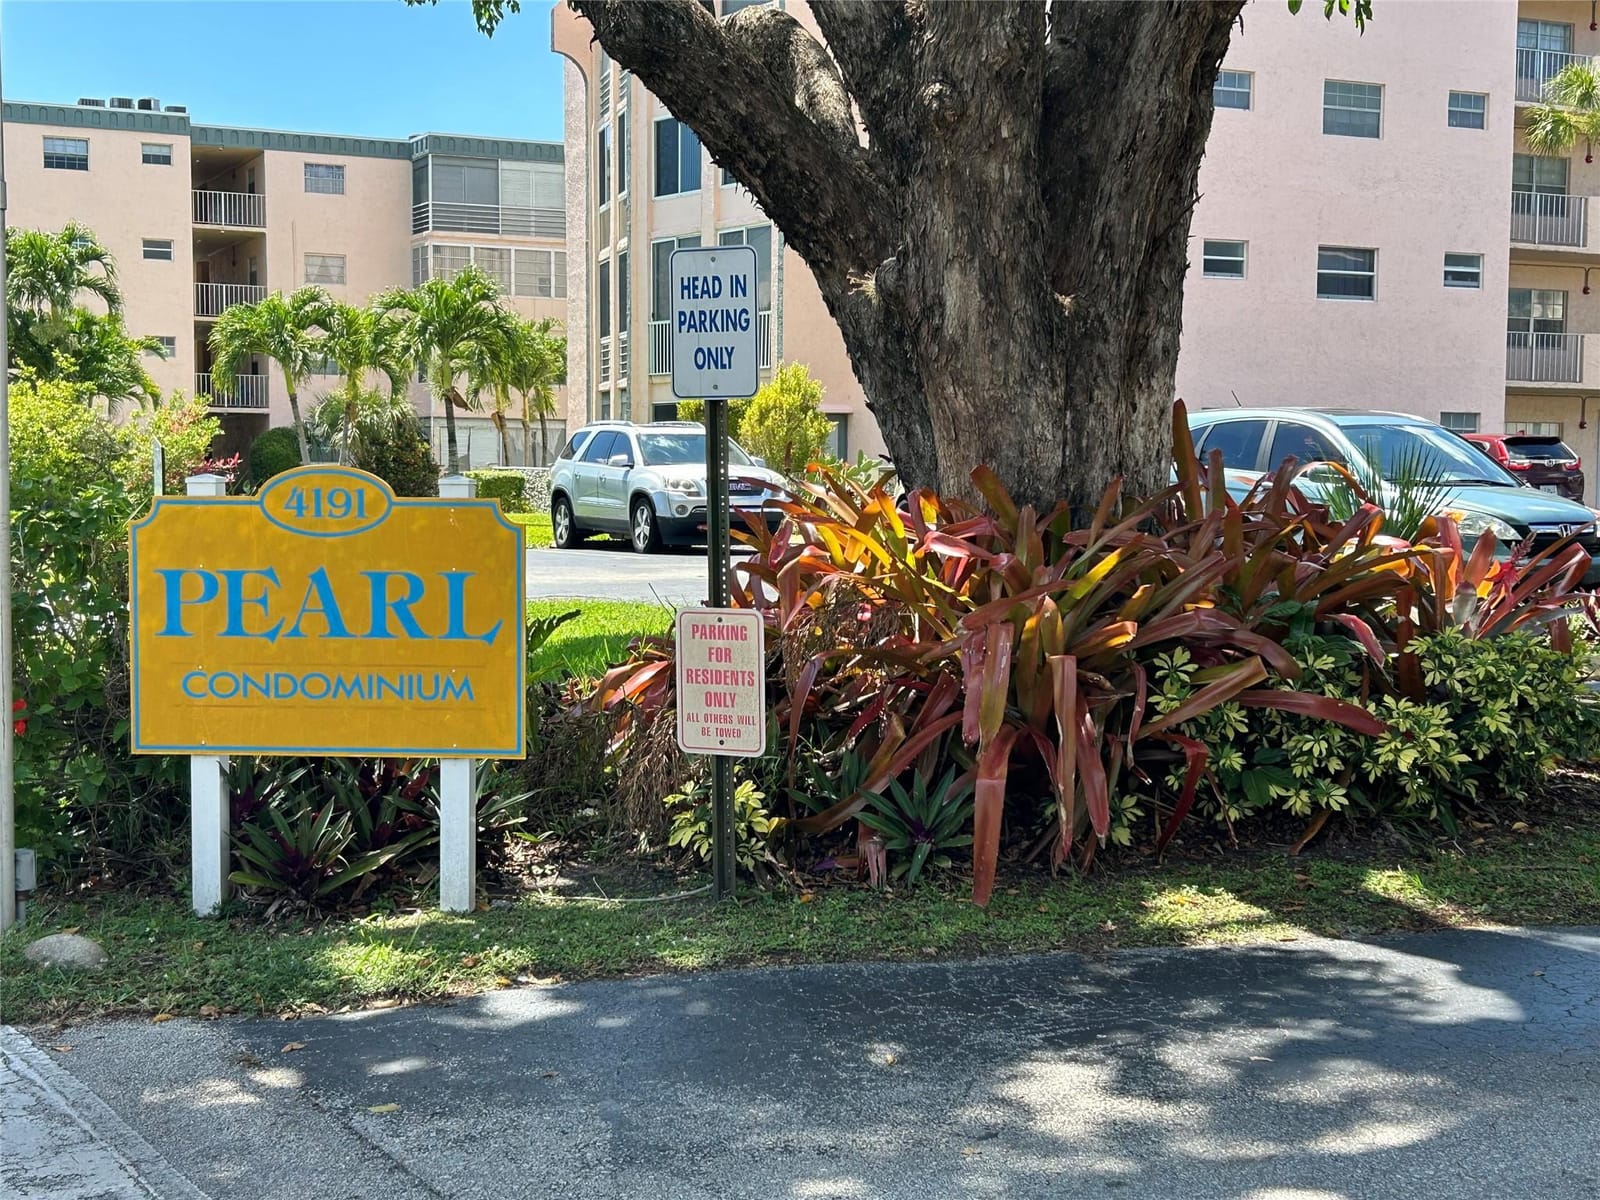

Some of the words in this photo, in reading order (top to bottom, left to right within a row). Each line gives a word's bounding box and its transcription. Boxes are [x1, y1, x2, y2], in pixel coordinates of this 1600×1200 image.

[680, 275, 722, 300] HEAD
[730, 274, 747, 298] IN
[678, 308, 750, 333] PARKING
[694, 346, 735, 370] ONLY
[283, 487, 368, 520] 4191
[153, 565, 504, 646] PEARL
[691, 623, 748, 642] PARKING
[708, 647, 732, 663] FOR
[181, 671, 475, 701] CONDOMINIUM
[686, 668, 755, 687] RESIDENTS
[704, 691, 737, 708] ONLY
[686, 712, 700, 723] ALL
[703, 713, 733, 725] OTHERS
[737, 715, 757, 726] WILL
[701, 727, 711, 737] BE
[715, 727, 742, 738] TOWED
